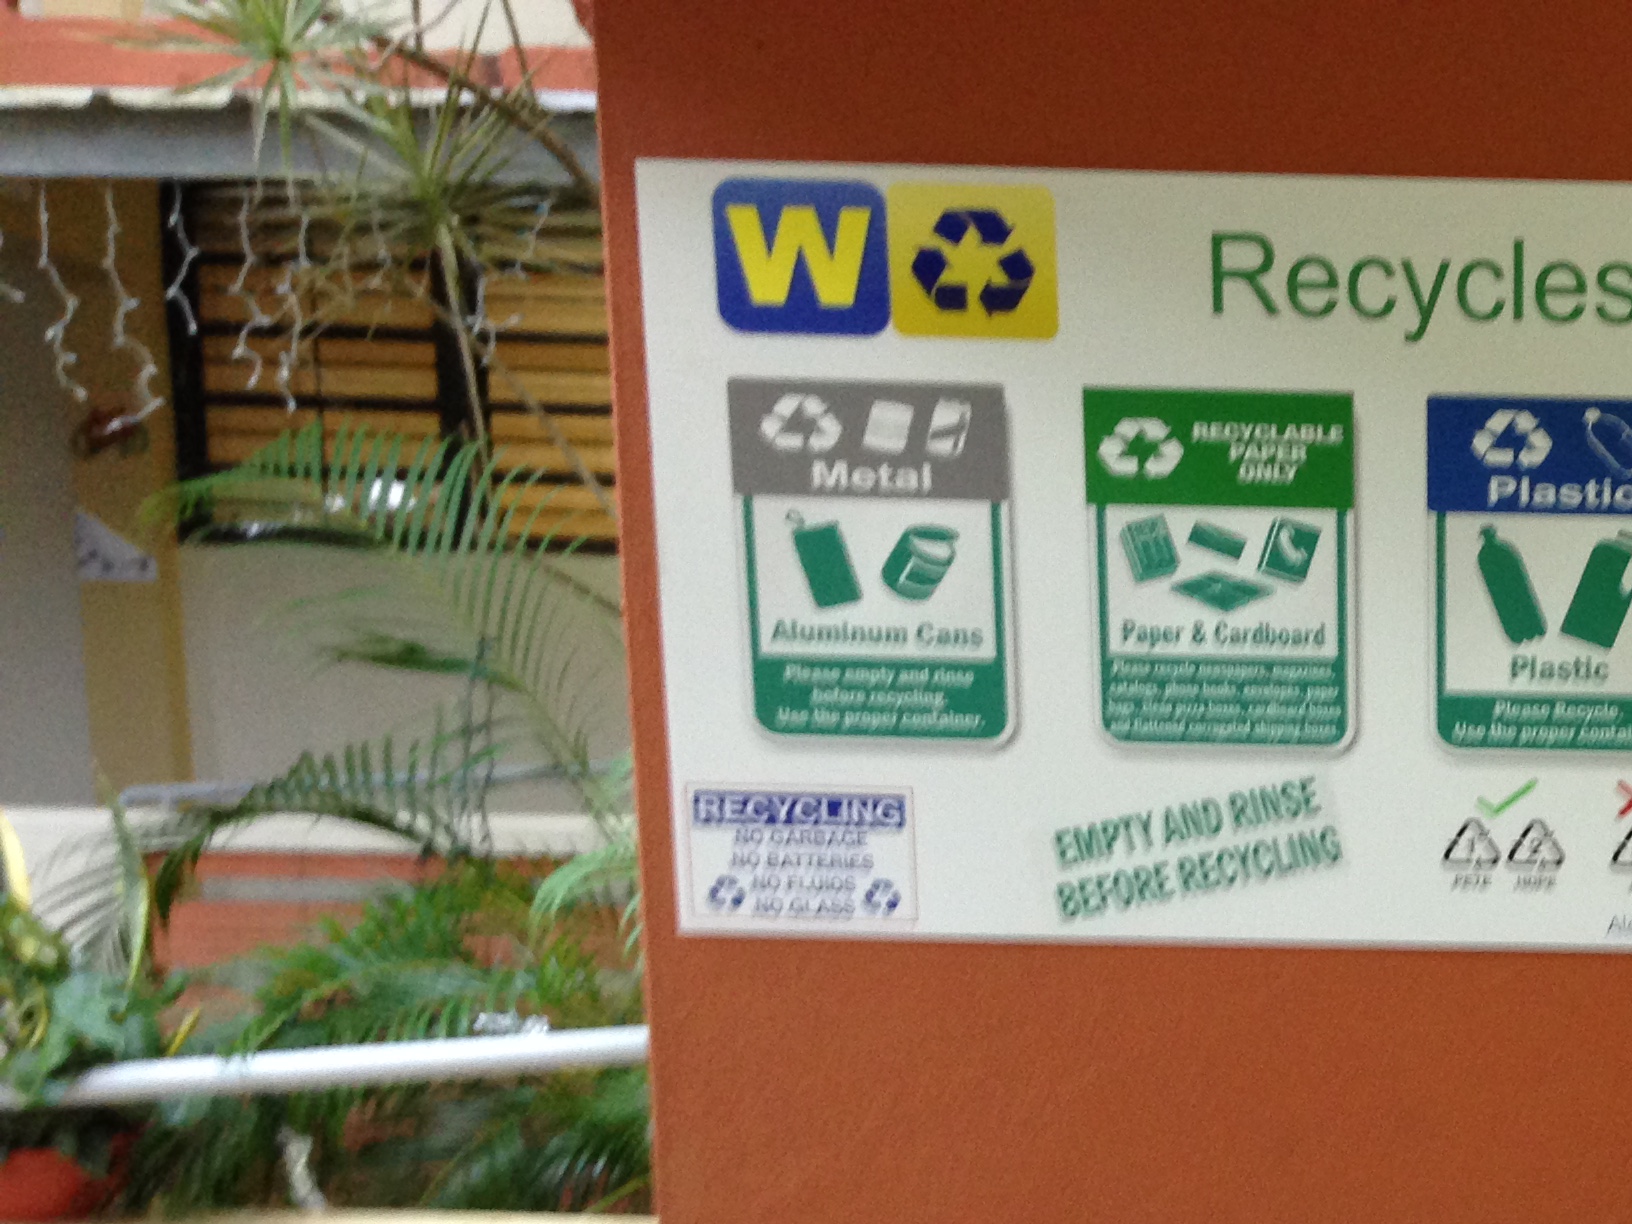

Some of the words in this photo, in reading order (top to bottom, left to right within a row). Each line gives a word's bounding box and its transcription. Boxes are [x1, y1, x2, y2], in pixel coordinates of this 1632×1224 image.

[724, 203, 872, 309] W
[1192, 421, 1344, 445] RECYCLABLE
[1229, 442, 1308, 465] PAPER
[811, 458, 933, 492] Metal
[1238, 462, 1298, 485] ONLY
[771, 618, 909, 645] Aluminum
[915, 621, 984, 648] Cans
[1121, 618, 1185, 652] Paper
[1190, 619, 1207, 646] &
[1213, 620, 1327, 647] Cardboard
[784, 663, 841, 683] Please
[843, 665, 896, 688] empty
[897, 667, 930, 686] and
[932, 668, 975, 688] rinse
[1510, 653, 1610, 683] Plastic
[811, 686, 867, 705] before
[777, 706, 809, 727] Use
[811, 706, 841, 728] the
[843, 709, 898, 731] proper
[1494, 700, 1550, 720] Please
[1454, 721, 1486, 743] Use
[1488, 721, 1517, 743] the
[1520, 724, 1577, 746] proper
[700, 793, 901, 825] RECYCLING
[1055, 808, 1154, 869] EMPTY
[1163, 795, 1225, 847] AND
[1228, 774, 1322, 832] RINSE
[735, 827, 764, 846] NO
[769, 828, 868, 846] GARBAGE
[731, 851, 761, 869] NO
[766, 852, 875, 870] BATTERIES
[1056, 859, 1176, 922] BEFORE
[1177, 824, 1344, 894] RECYCLING
[752, 875, 781, 893] NO
[786, 876, 857, 892] FLUIDS
[754, 897, 784, 915] NO
[789, 898, 856, 916] GLASS
